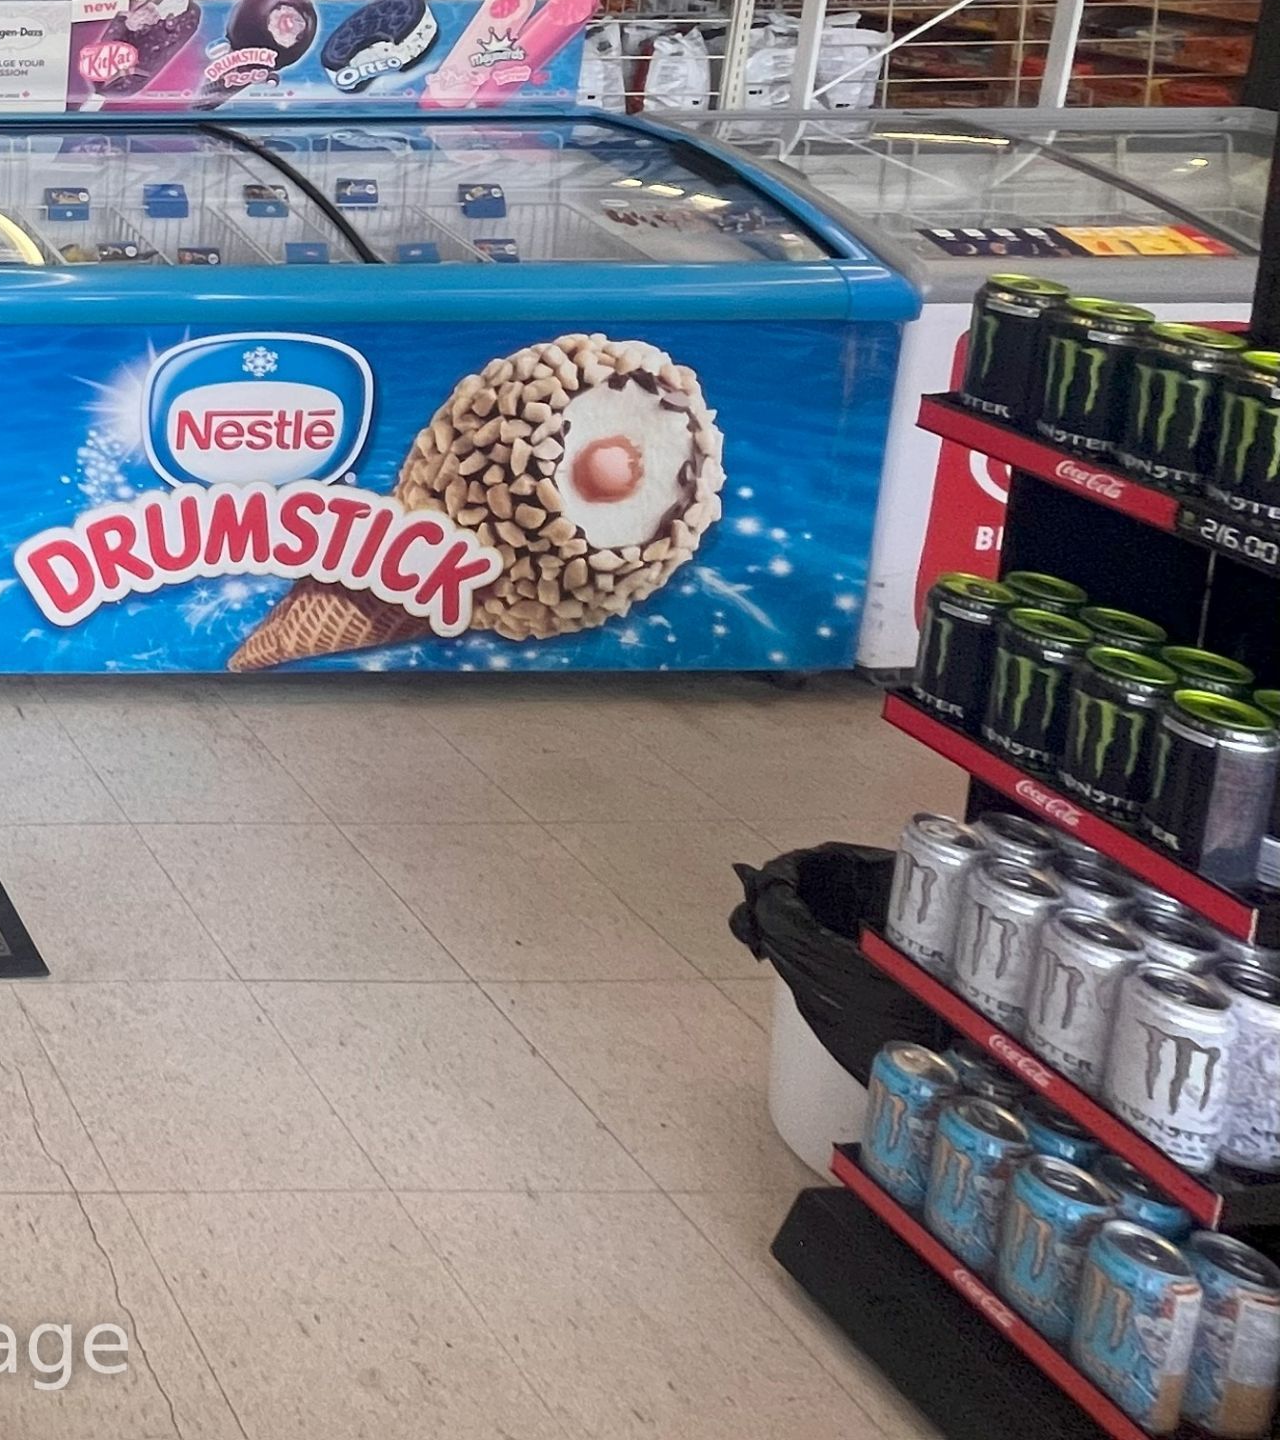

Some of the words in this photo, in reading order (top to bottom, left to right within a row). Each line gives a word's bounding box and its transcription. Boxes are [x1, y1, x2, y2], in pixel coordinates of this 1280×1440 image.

[83, 0, 119, 14] new
[18, 59, 45, 68] YOUR
[207, 49, 279, 81] DRUMSTICK
[337, 55, 402, 85] OREO
[175, 408, 337, 452] Nestlé
[26, 491, 493, 625] DRUMSTICK
